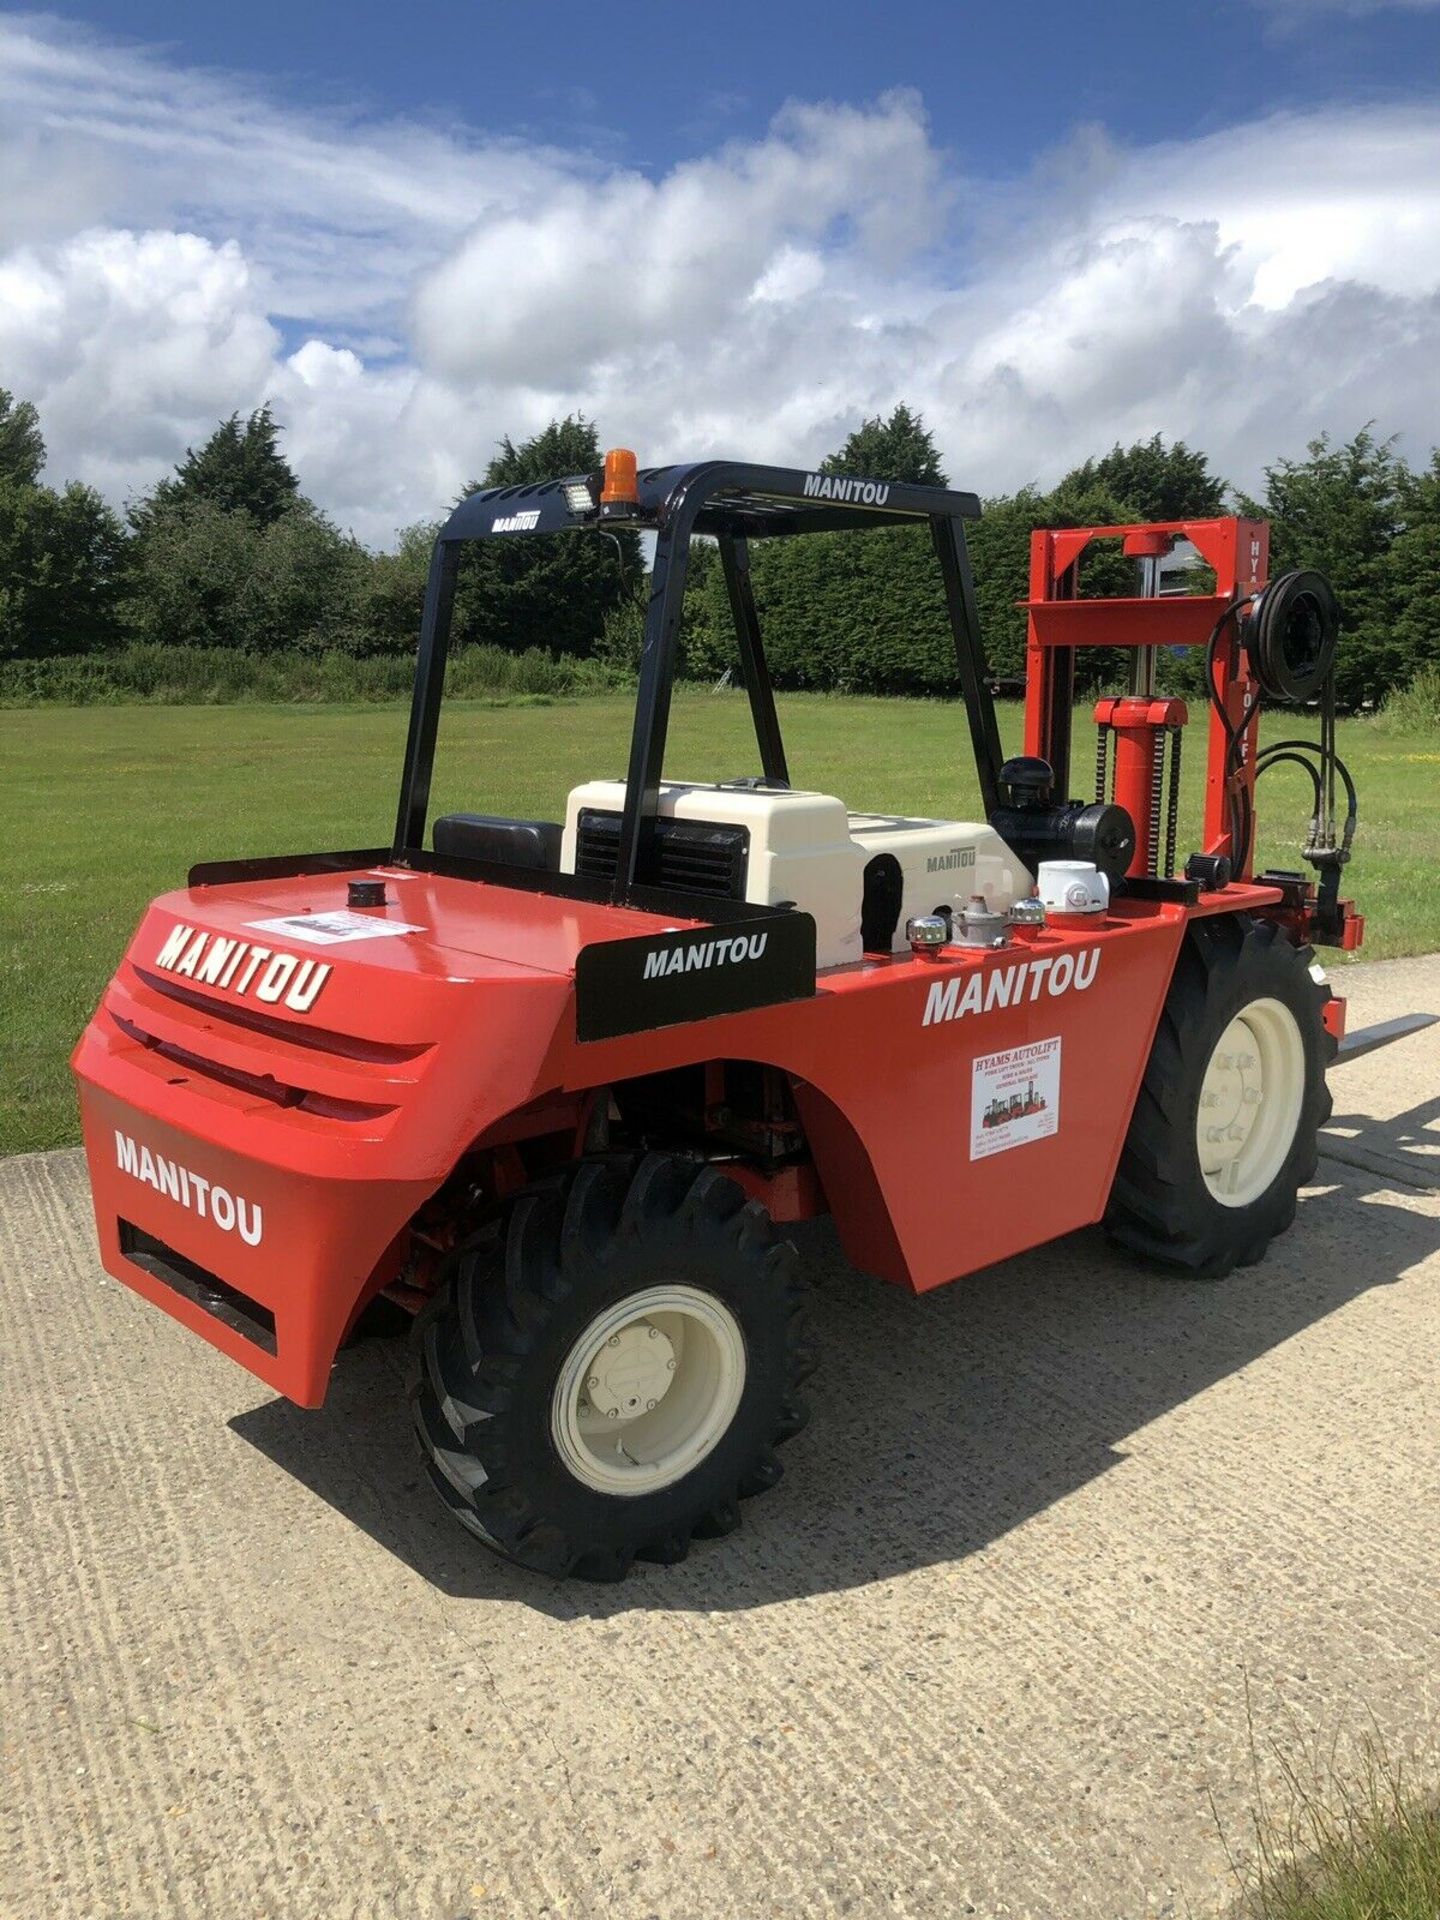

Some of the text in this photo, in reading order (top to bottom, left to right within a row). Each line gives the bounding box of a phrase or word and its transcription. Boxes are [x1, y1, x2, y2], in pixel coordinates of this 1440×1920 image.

[804, 474, 890, 505] MANITOU
[491, 509, 541, 533] MANITOU
[926, 845, 976, 873] MANITOU
[155, 923, 334, 1013] MANITOU
[643, 932, 768, 980] MANITOU
[922, 948, 1101, 1027] MANITOU
[975, 1040, 1059, 1073] HYAMS AUTOLIFT
[115, 1130, 262, 1247] MANITOU
